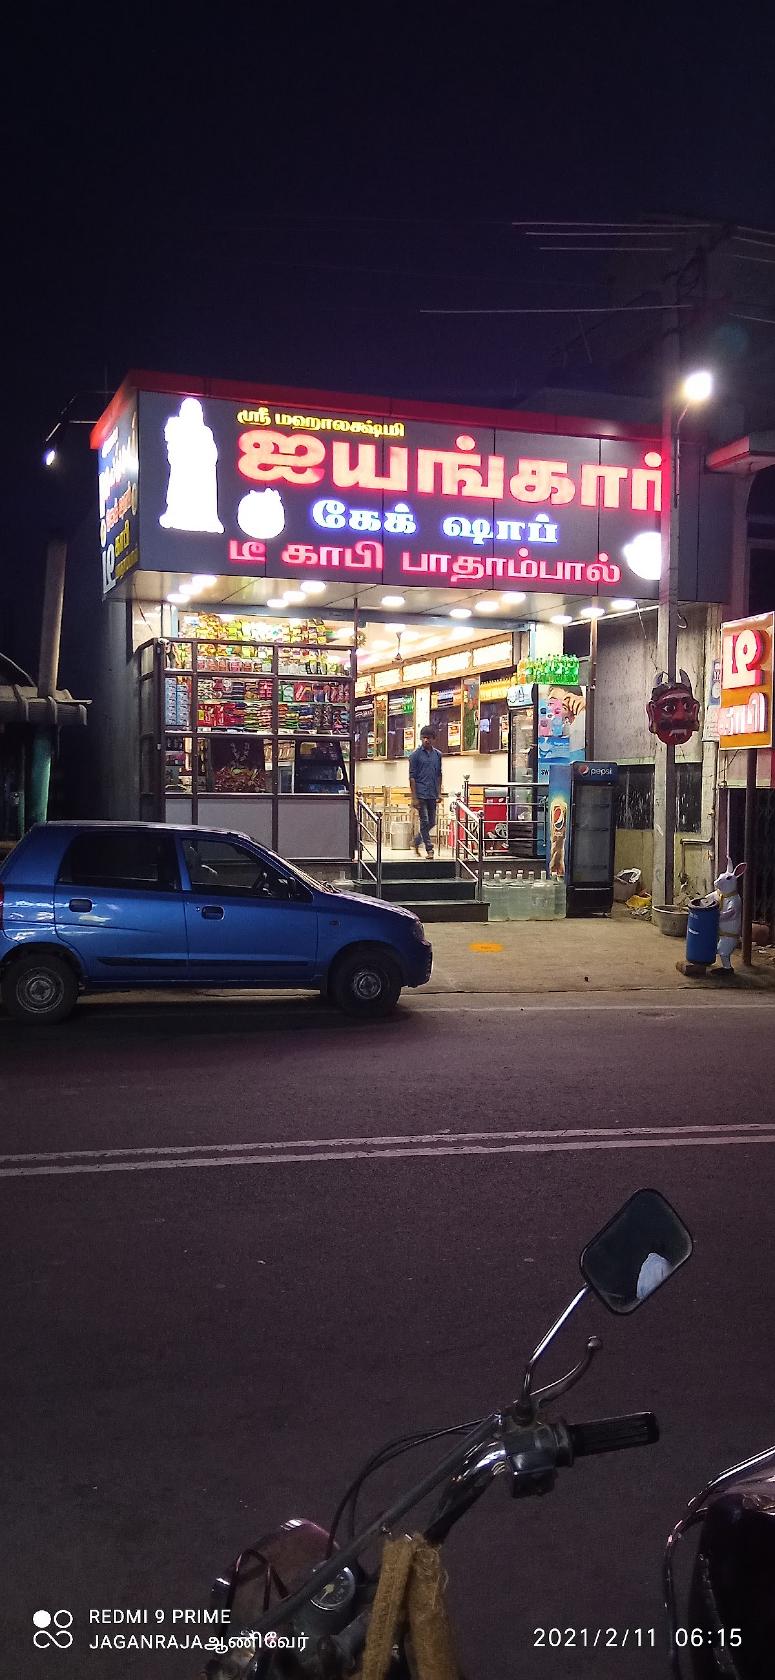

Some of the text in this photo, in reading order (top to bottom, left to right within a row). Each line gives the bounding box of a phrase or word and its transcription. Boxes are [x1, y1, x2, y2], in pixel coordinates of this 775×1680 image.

[237, 430, 662, 512] ஐயங்கார்
[312, 499, 559, 545] கேக் ஷாப்
[229, 540, 622, 583] டீ காபி பாதாம்பால்
[590, 767, 613, 777] pepsi
